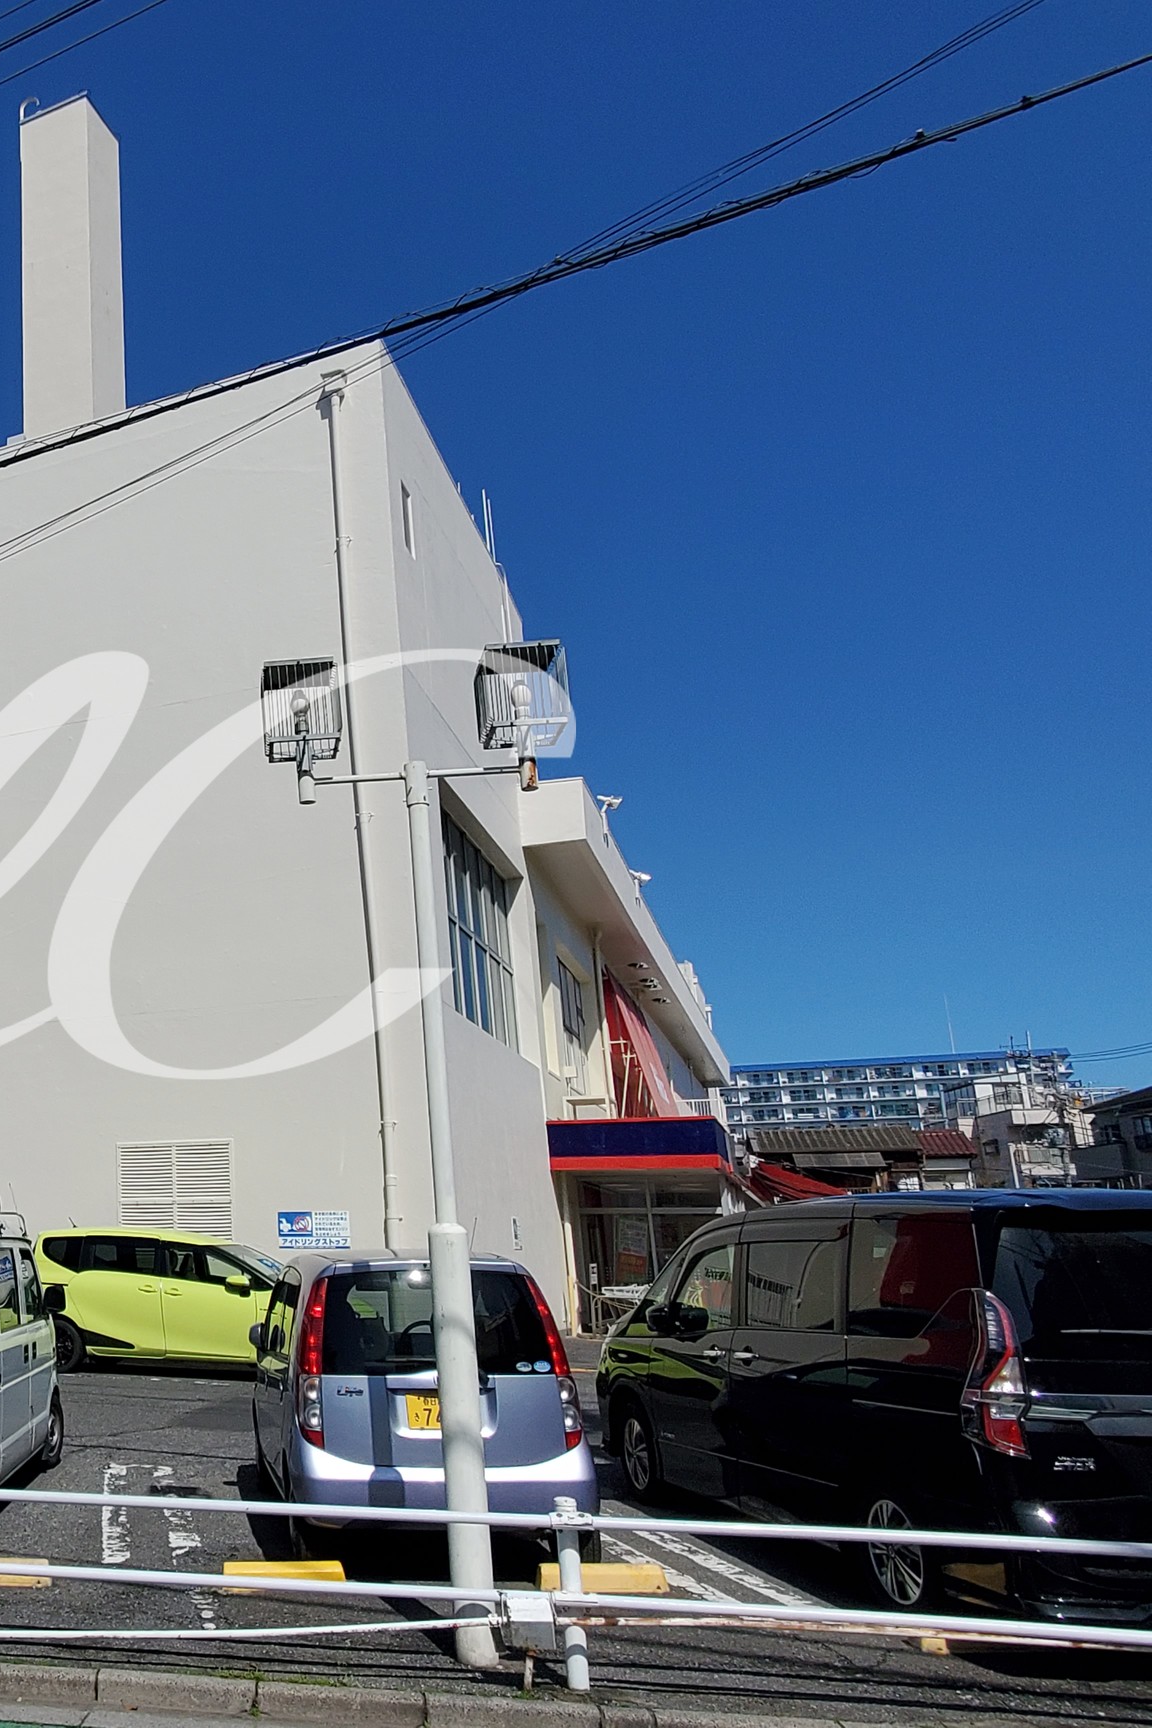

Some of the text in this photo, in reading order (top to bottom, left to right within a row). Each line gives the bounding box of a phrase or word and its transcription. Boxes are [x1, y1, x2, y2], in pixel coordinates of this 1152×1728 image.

[281, 1238, 348, 1246] アイドリングストップ
